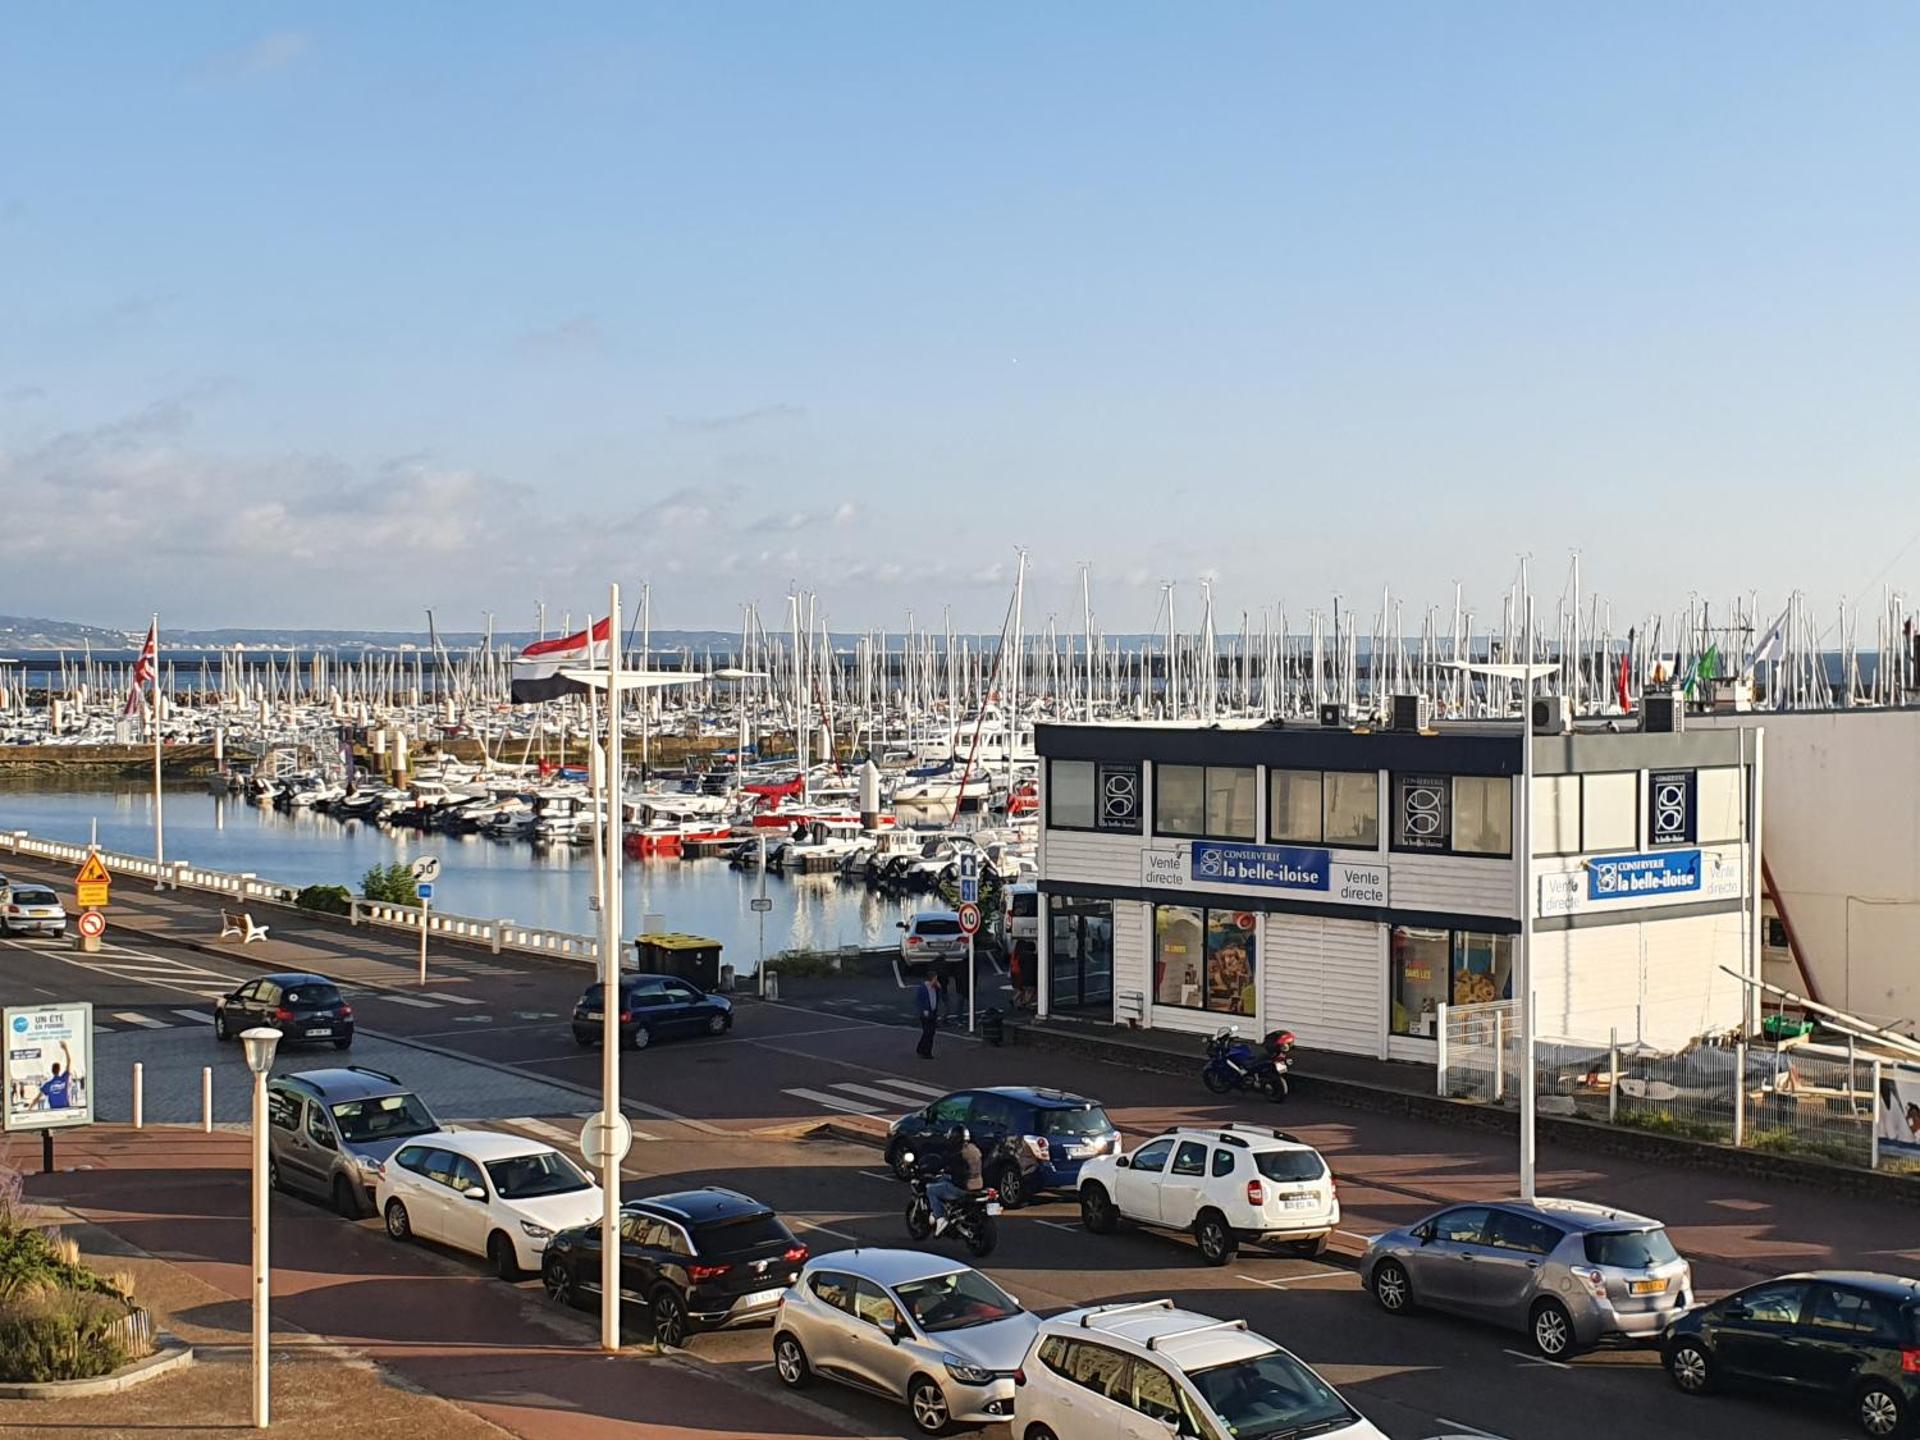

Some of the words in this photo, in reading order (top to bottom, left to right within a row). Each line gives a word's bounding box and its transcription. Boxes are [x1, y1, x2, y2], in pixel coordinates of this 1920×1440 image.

[1149, 855, 1181, 869] Vente
[1223, 849, 1281, 862] CONSERVERIE
[418, 863, 434, 875] 30
[1223, 860, 1236, 877] la
[1239, 862, 1319, 883] belle-iloise
[1146, 871, 1183, 885] directe
[1344, 869, 1380, 885] Vente
[1617, 873, 1629, 891] la
[1631, 868, 1695, 890] belle-iloise
[1340, 886, 1383, 901] directe
[964, 912, 975, 925] 10
